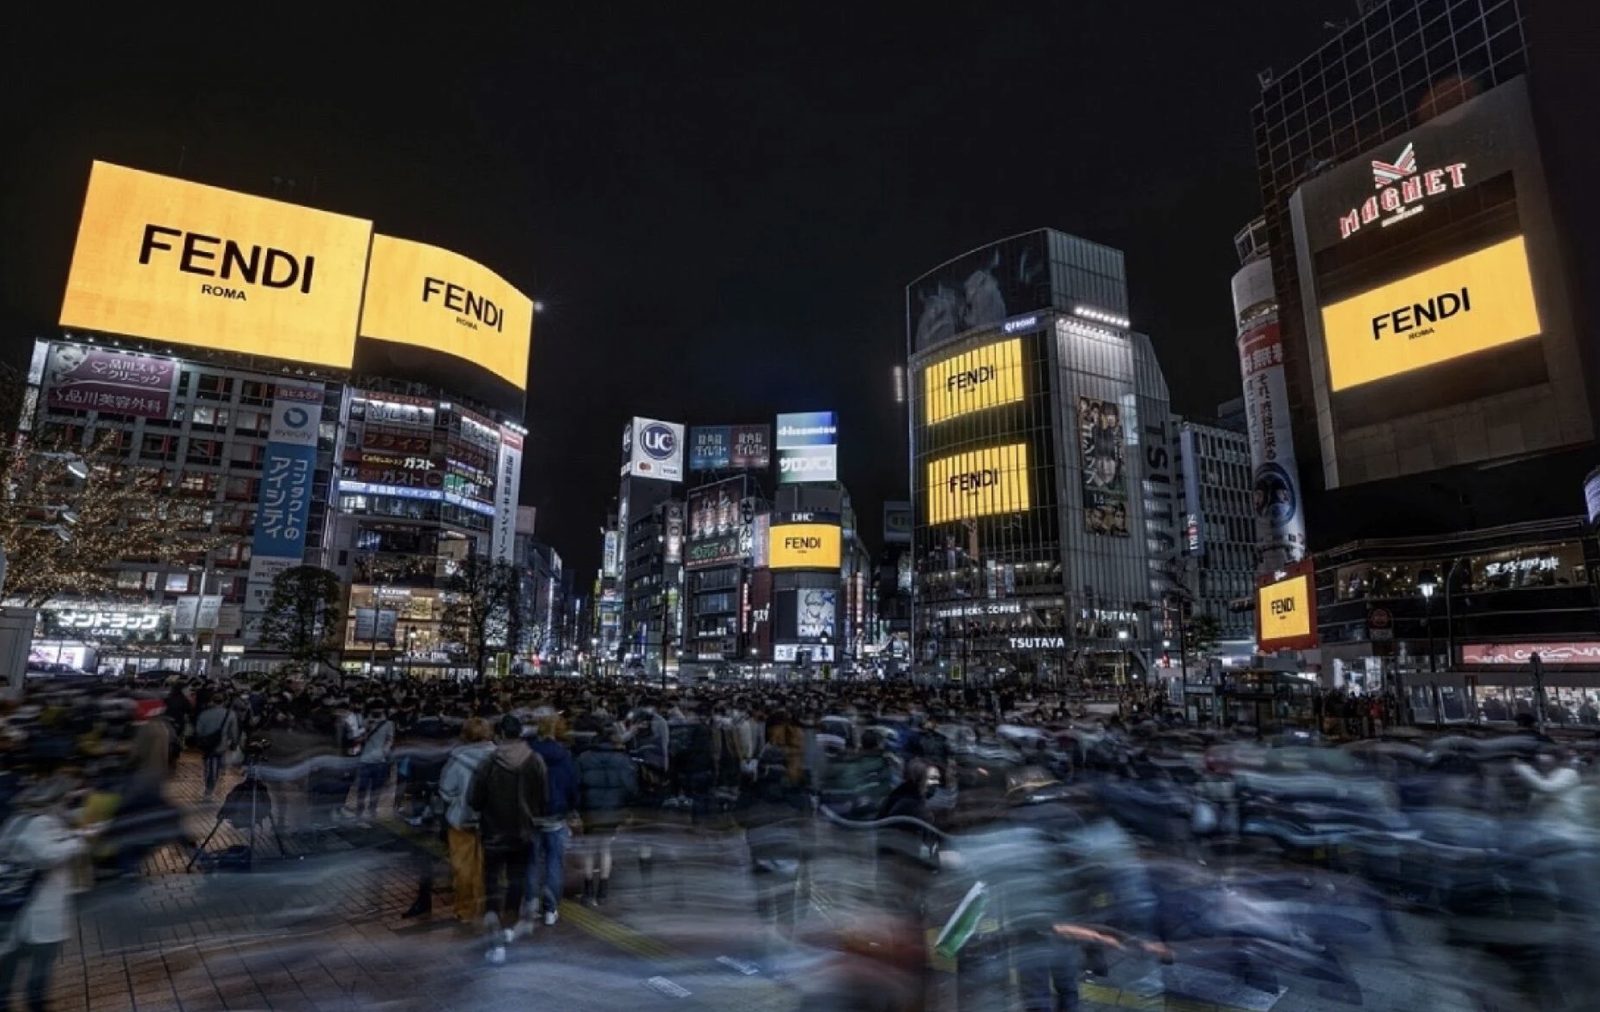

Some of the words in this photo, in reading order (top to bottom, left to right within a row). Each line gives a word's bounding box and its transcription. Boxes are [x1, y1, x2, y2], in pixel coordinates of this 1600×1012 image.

[1339, 162, 1467, 239] MAGNET
[138, 223, 315, 294] FENDI
[201, 284, 247, 301] ROMA
[422, 276, 504, 333] FENDI
[1371, 286, 1471, 341] FENDI
[456, 316, 478, 331] ROMA
[1408, 327, 1436, 340] ROMA
[107, 369, 161, 385] クリニック
[947, 364, 994, 392] FENDI
[65, 389, 161, 413] 品川美容外科
[645, 431, 673, 452] UC
[404, 456, 436, 471] ガスト
[949, 467, 998, 493] FENDI
[262, 456, 291, 538] アイシティ
[283, 459, 308, 540] コンタクトの
[792, 512, 815, 522] DHC
[785, 536, 822, 550] FENDI
[939, 604, 983, 618] STARBCKS
[987, 604, 1021, 615] COFFEE
[1093, 608, 1139, 623] TSUTAYA
[1271, 597, 1295, 615] FENDI
[57, 610, 161, 630] サンドラッグ
[1009, 636, 1065, 649] TSUTAYA
